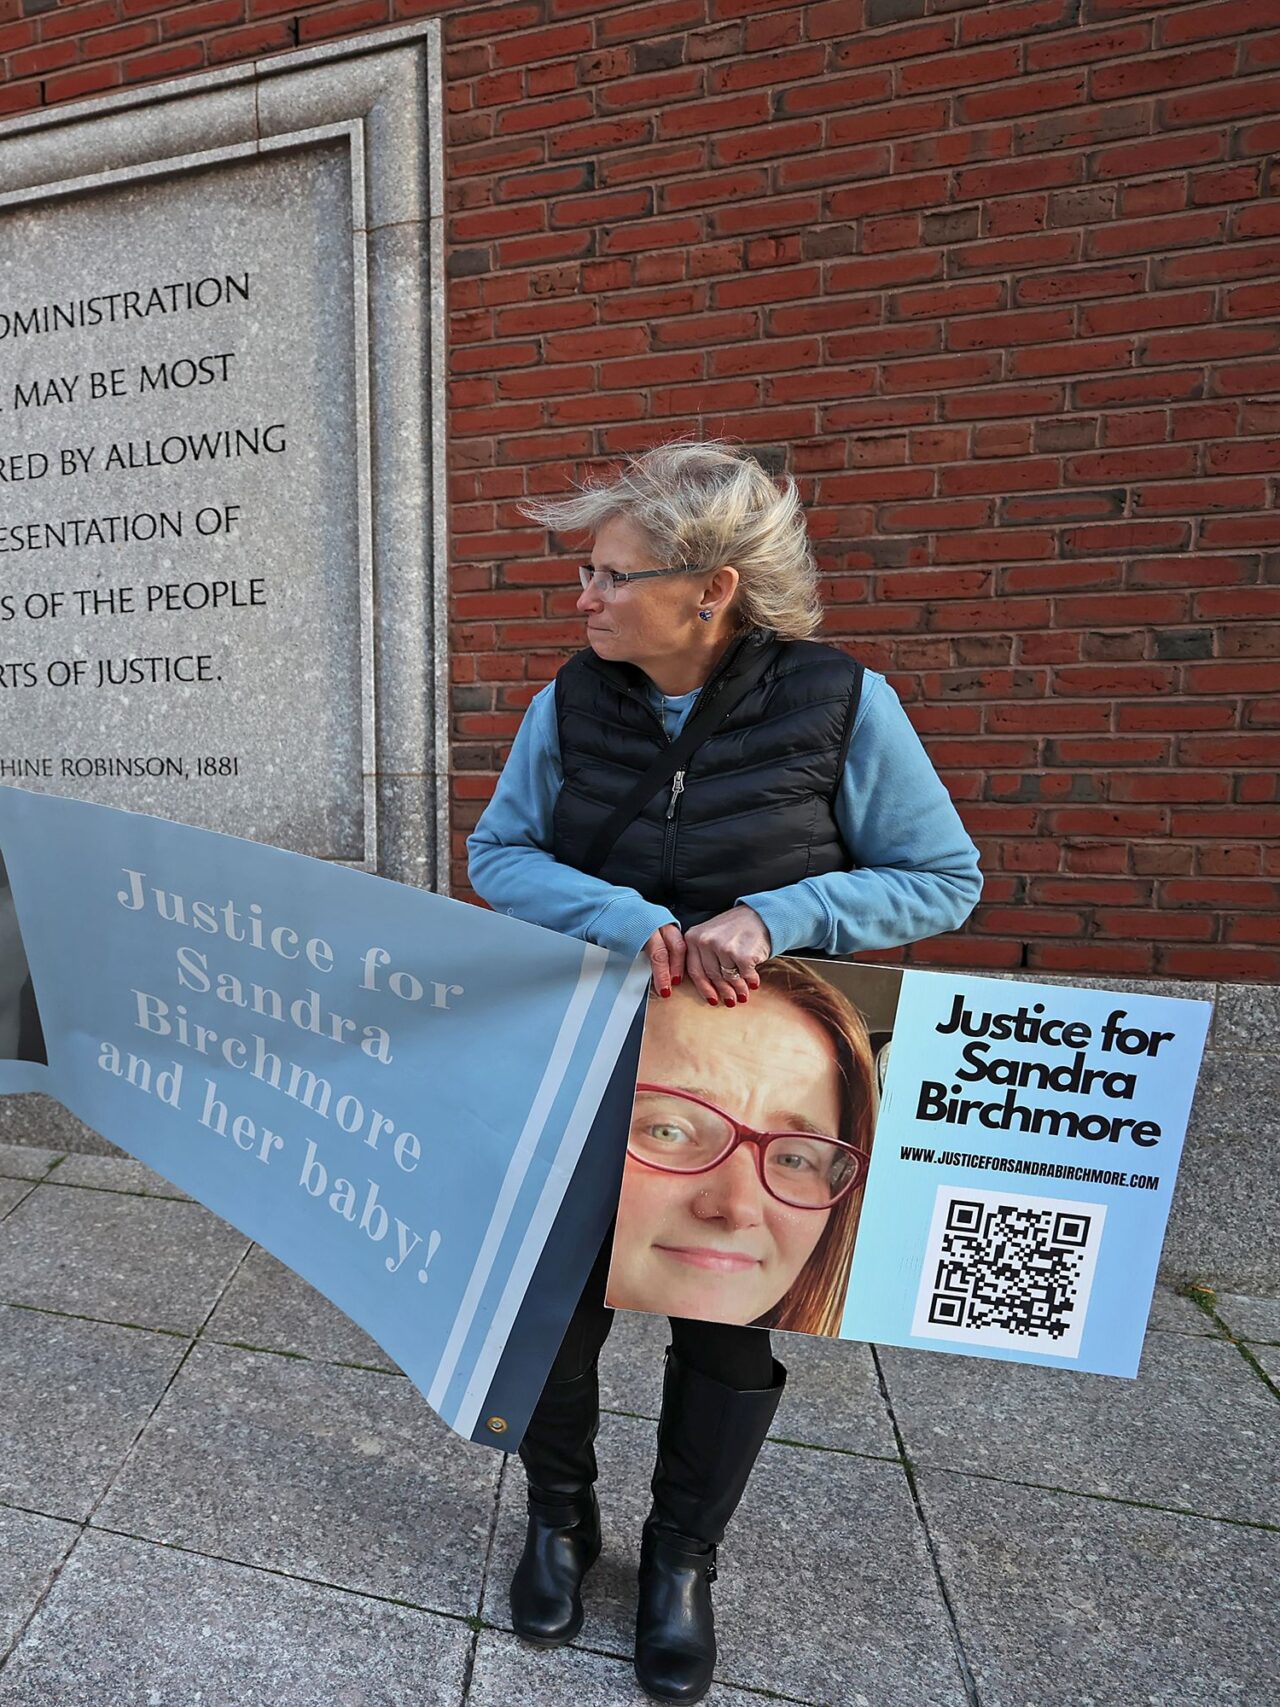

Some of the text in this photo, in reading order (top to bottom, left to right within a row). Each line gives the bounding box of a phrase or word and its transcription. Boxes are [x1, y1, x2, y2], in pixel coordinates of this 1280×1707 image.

[13, 377, 77, 409] MAY
[90, 369, 126, 398] BE
[139, 354, 235, 393] MOST
[61, 447, 95, 477] BY
[104, 424, 287, 471] ALLOWING
[196, 506, 241, 535] OF
[25, 592, 65, 620] OF
[73, 587, 134, 616] THE
[146, 578, 267, 612] PEOPLE
[47, 661, 86, 687] OF
[94, 655, 222, 688] JUSTICE.
[62, 756, 190, 781] ROBINSON,
[196, 756, 239, 776] 1881
[117, 868, 465, 1011] Justice for
[176, 946, 394, 1065] Sandra
[935, 994, 1175, 1059] Justice for
[130, 988, 421, 1173] Birchmore
[955, 1042, 1138, 1100] Sandra
[915, 1080, 1162, 1148] Birchmore
[97, 1040, 442, 1284] and her baby!
[900, 1146, 1160, 1191] WWW.JUSTICEFORSANDRABIRCHMORE.COM
